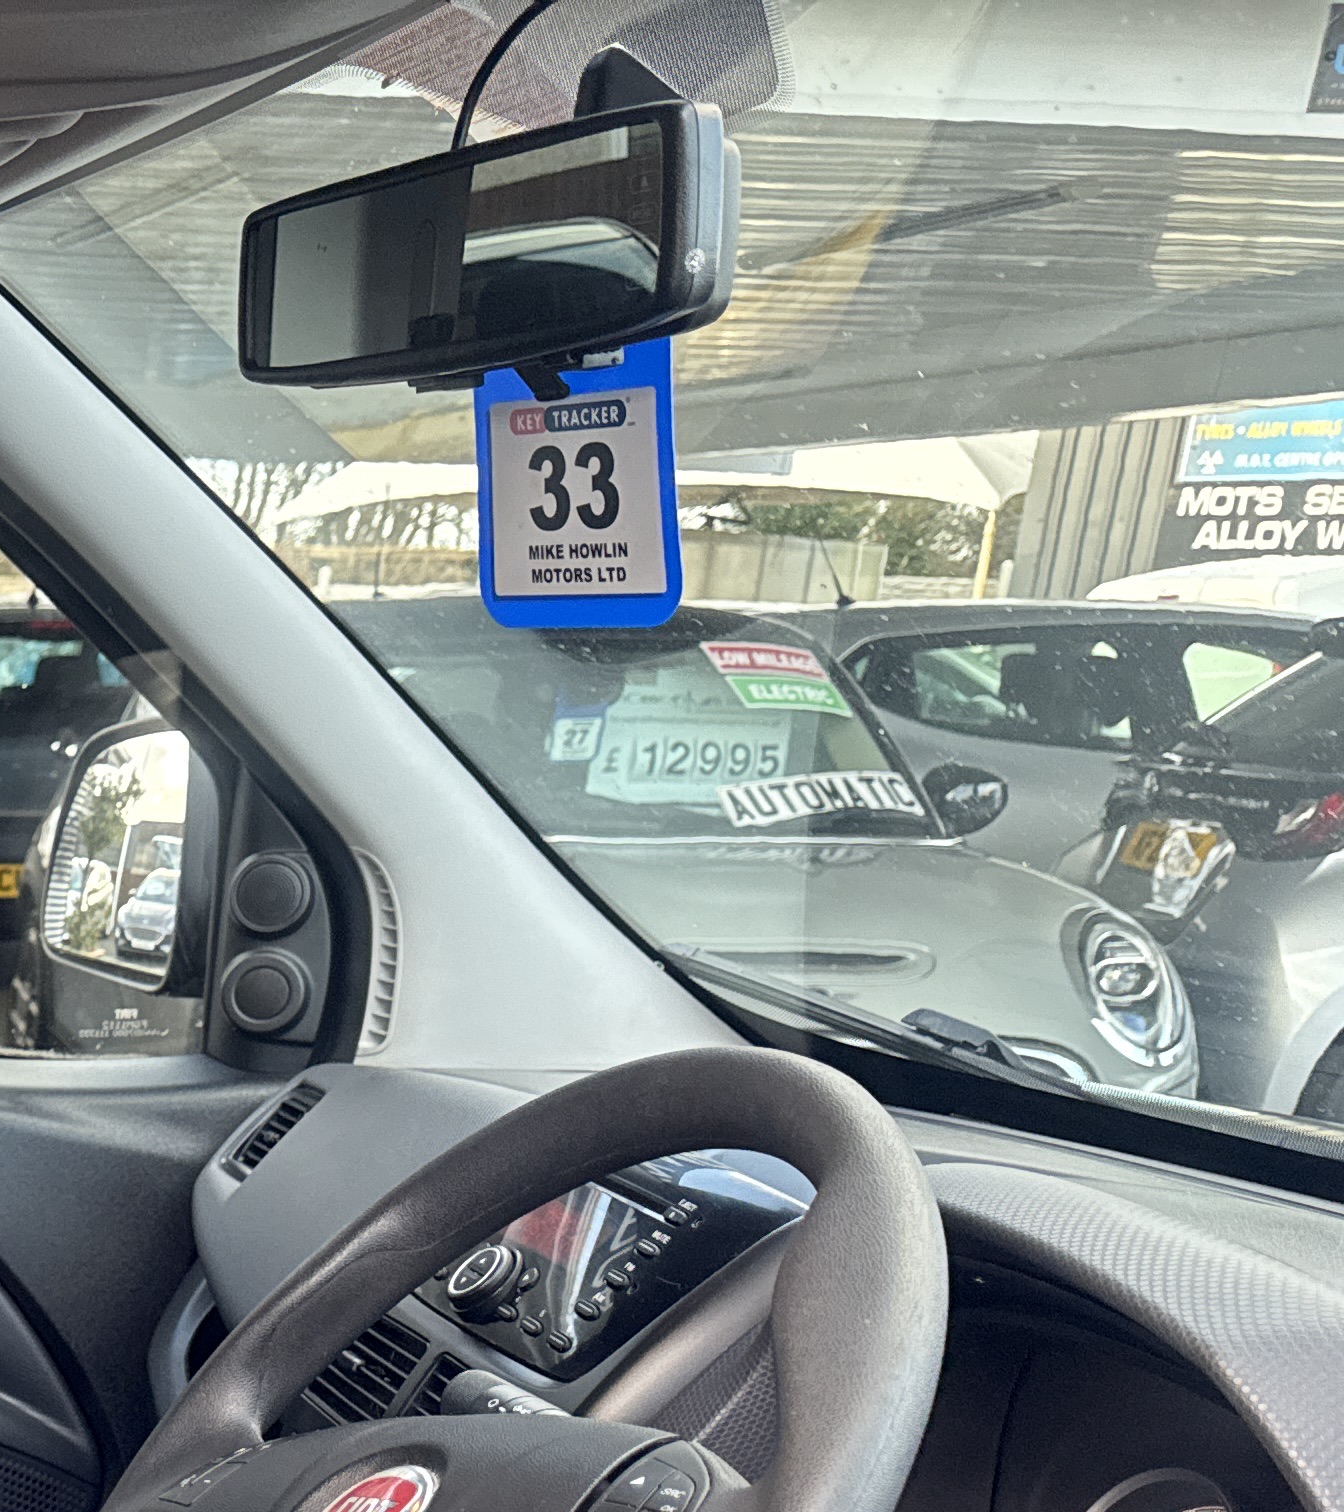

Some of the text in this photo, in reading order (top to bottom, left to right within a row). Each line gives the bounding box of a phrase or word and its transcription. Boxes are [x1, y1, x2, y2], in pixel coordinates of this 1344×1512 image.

[516, 405, 620, 432] KEY TRACKER
[528, 441, 620, 532] 33
[528, 541, 629, 561] MIKE HOWLIN
[1191, 519, 1309, 551] ALLOY
[531, 566, 627, 584] MOTORS LTD
[641, 739, 781, 778] 12995
[726, 775, 917, 822] AUTOMATIC
